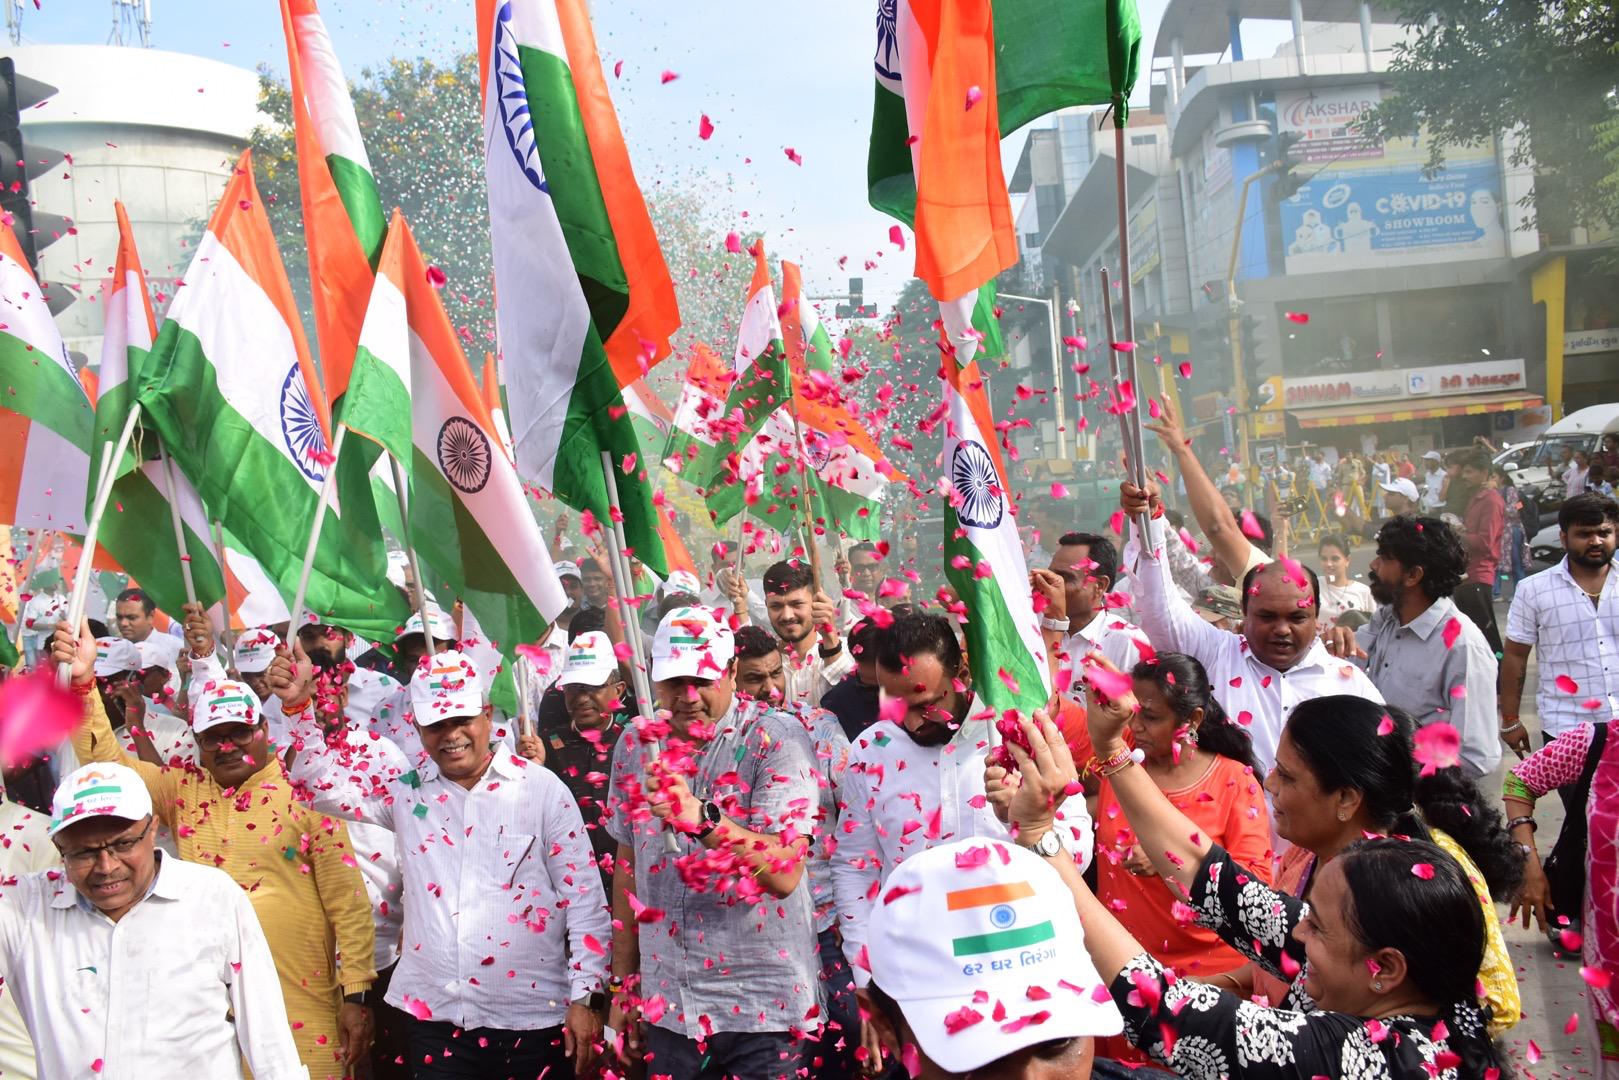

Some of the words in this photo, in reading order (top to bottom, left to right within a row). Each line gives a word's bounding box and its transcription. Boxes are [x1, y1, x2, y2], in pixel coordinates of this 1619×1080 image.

[1305, 100, 1379, 117] AKSHAR
[1375, 191, 1467, 214] COVID-19
[1384, 214, 1465, 230] SHOWROOM
[1286, 382, 1351, 402] SHIVAM
[963, 963, 983, 976] હર
[991, 959, 1012, 970] ઘર
[1020, 948, 1056, 967] તિરંગા
